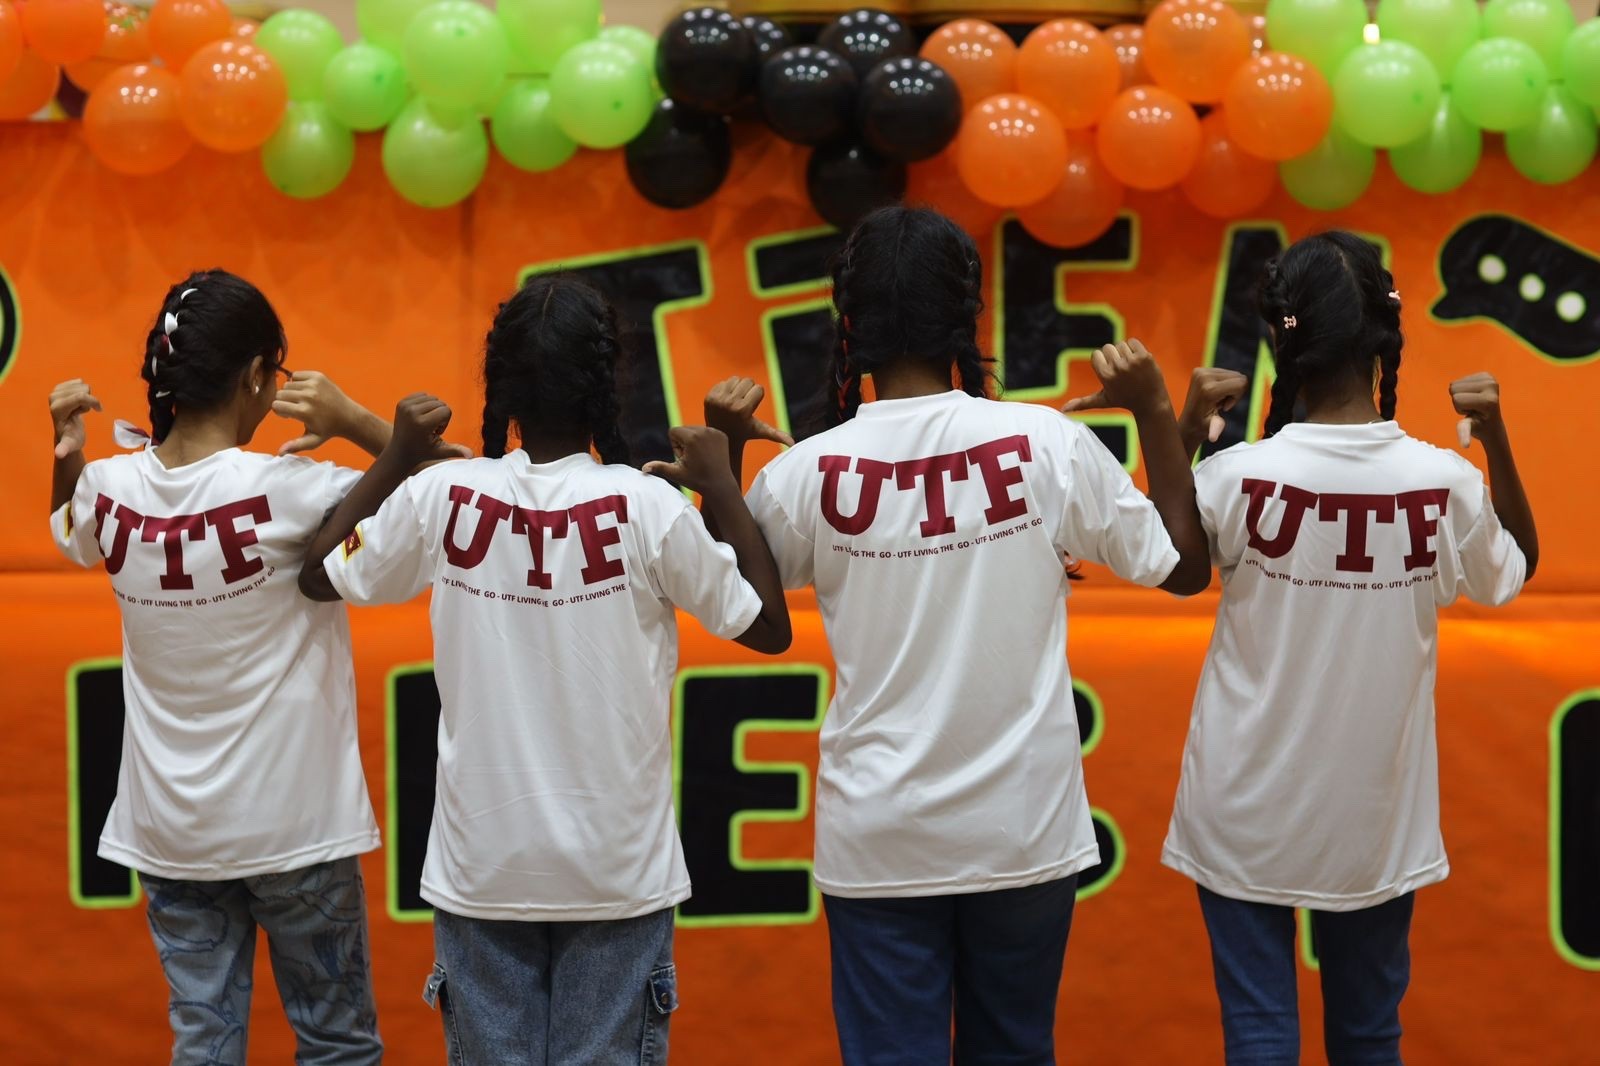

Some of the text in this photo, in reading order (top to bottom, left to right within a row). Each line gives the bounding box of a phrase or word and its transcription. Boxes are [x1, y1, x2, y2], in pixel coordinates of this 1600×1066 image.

[818, 434, 1032, 538] UTF
[94, 492, 273, 591] UTF
[443, 484, 629, 589] UTF
[861, 550, 876, 558] THE
[879, 551, 892, 559] GO
[897, 551, 912, 559] UTF
[914, 547, 939, 557] LIVING
[940, 543, 955, 553] THE
[957, 541, 970, 550] GO
[975, 535, 988, 545] UTF
[988, 527, 1014, 542] LIVING
[1014, 522, 1029, 533] THE
[1031, 517, 1043, 527] GO
[1241, 478, 1450, 573] UTF
[127, 595, 136, 604] GO
[195, 598, 207, 606] GO
[212, 594, 226, 603] UTF
[227, 584, 253, 599] LIVING
[253, 576, 266, 588] THE
[267, 566, 275, 576] GO
[484, 590, 496, 599] GO
[501, 593, 516, 602] UTF
[517, 596, 541, 605] LIVING
[552, 599, 564, 607] GO
[570, 595, 584, 604] UTF
[585, 588, 611, 601] LIVING
[611, 583, 626, 593] THE
[1309, 579, 1323, 587] UTF
[1324, 580, 1351, 590] LIVING
[1371, 582, 1383, 590] GO
[1389, 581, 1403, 589] UTF
